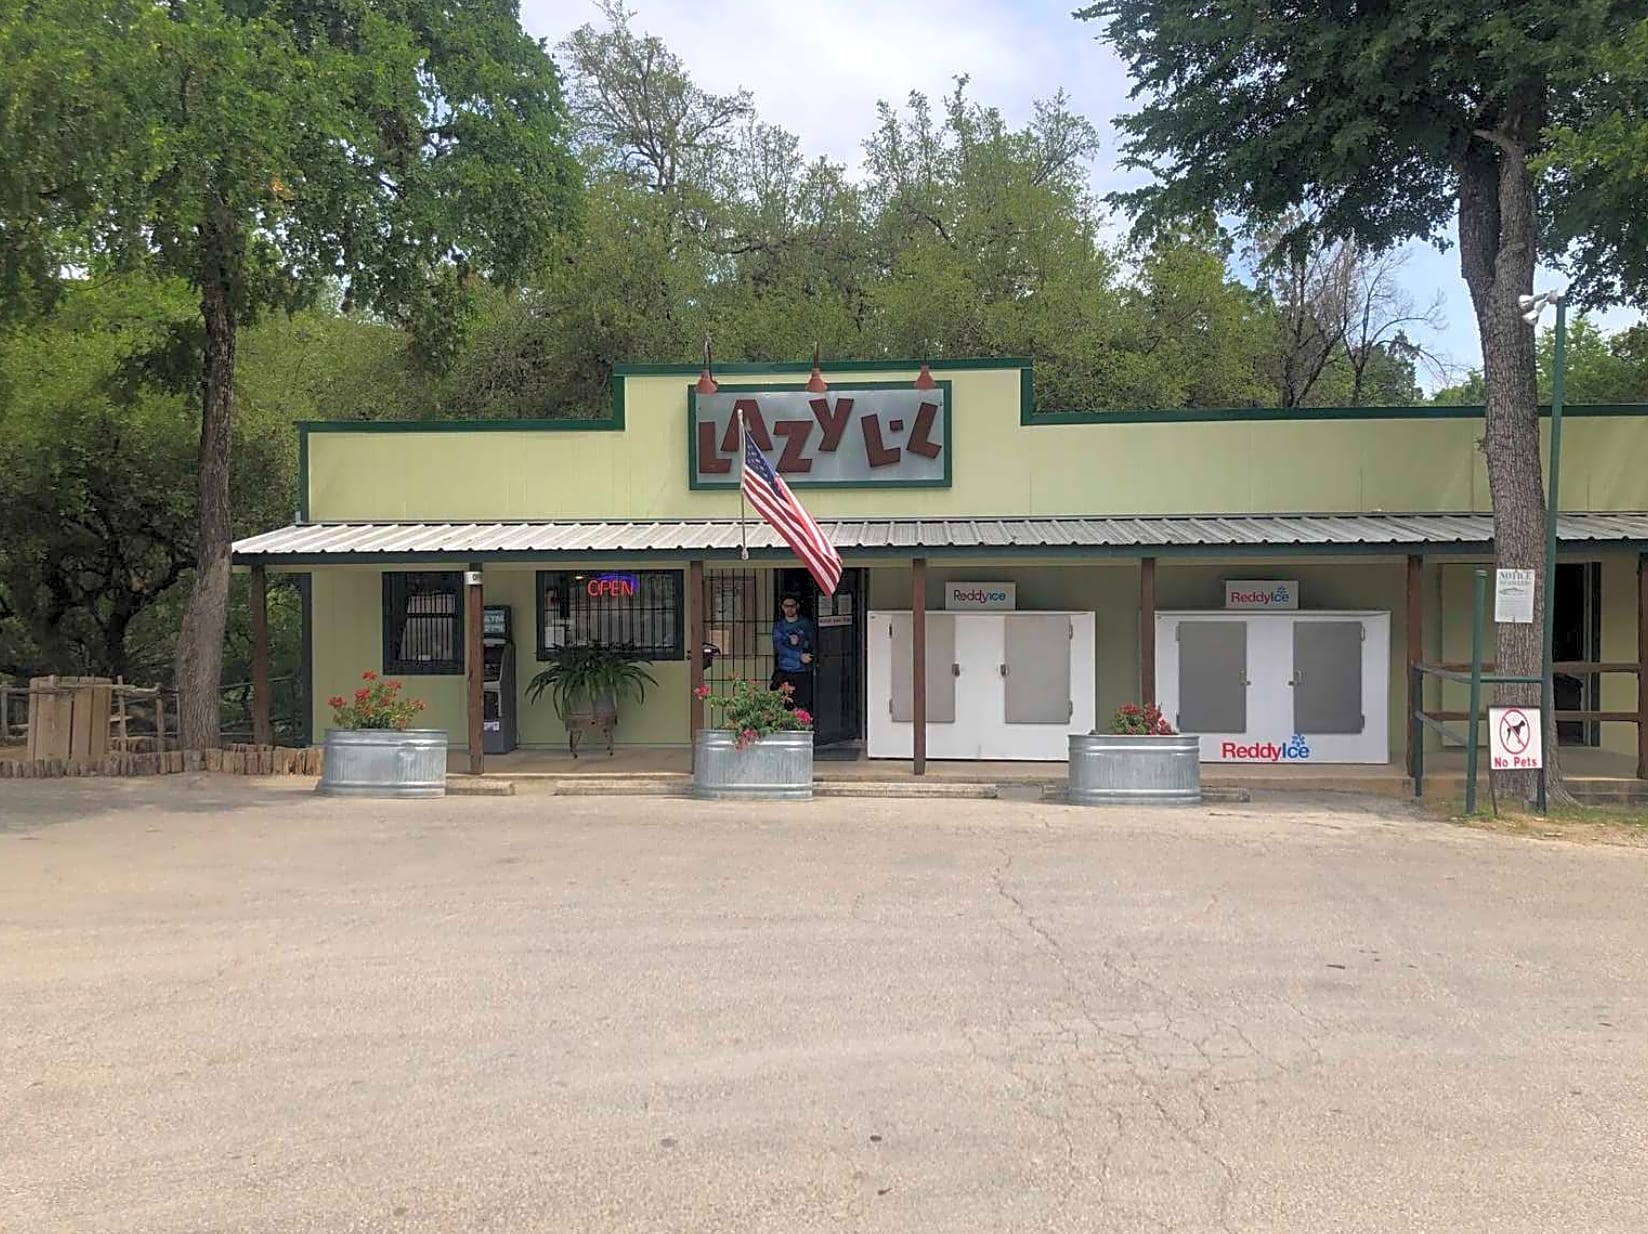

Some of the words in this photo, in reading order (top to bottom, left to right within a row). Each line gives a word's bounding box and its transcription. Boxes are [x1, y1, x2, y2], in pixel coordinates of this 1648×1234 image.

[699, 398, 854, 473] LAZY
[588, 580, 633, 597] OPEN
[1231, 591, 1290, 605] ReddyIce
[1222, 742, 1310, 762] ReddyIce
[1494, 756, 1509, 768] No
[1513, 756, 1538, 768] Pets
